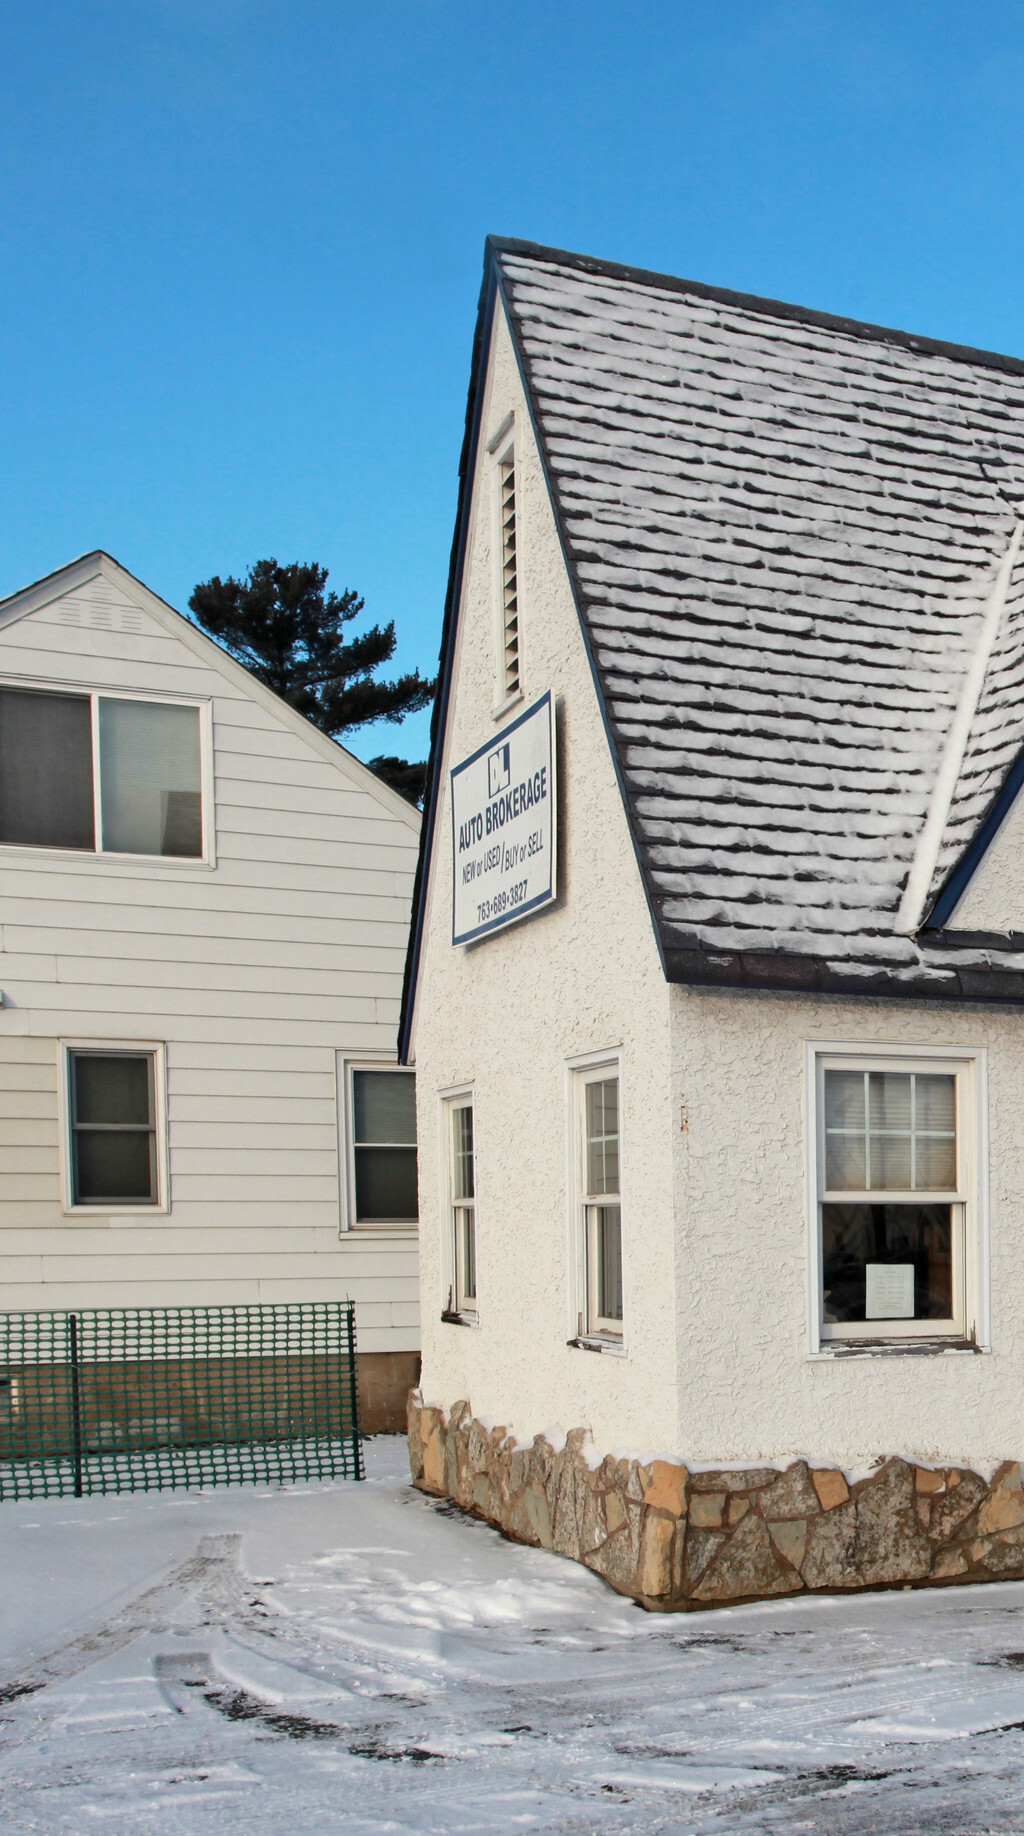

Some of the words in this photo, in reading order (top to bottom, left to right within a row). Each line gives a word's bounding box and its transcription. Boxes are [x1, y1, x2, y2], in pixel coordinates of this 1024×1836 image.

[459, 813, 483, 854] AUTO
[486, 766, 547, 836] BROKERAGE
[462, 859, 477, 886] NEW
[477, 860, 483, 877] or
[520, 844, 527, 862] or
[527, 828, 543, 857] SELL
